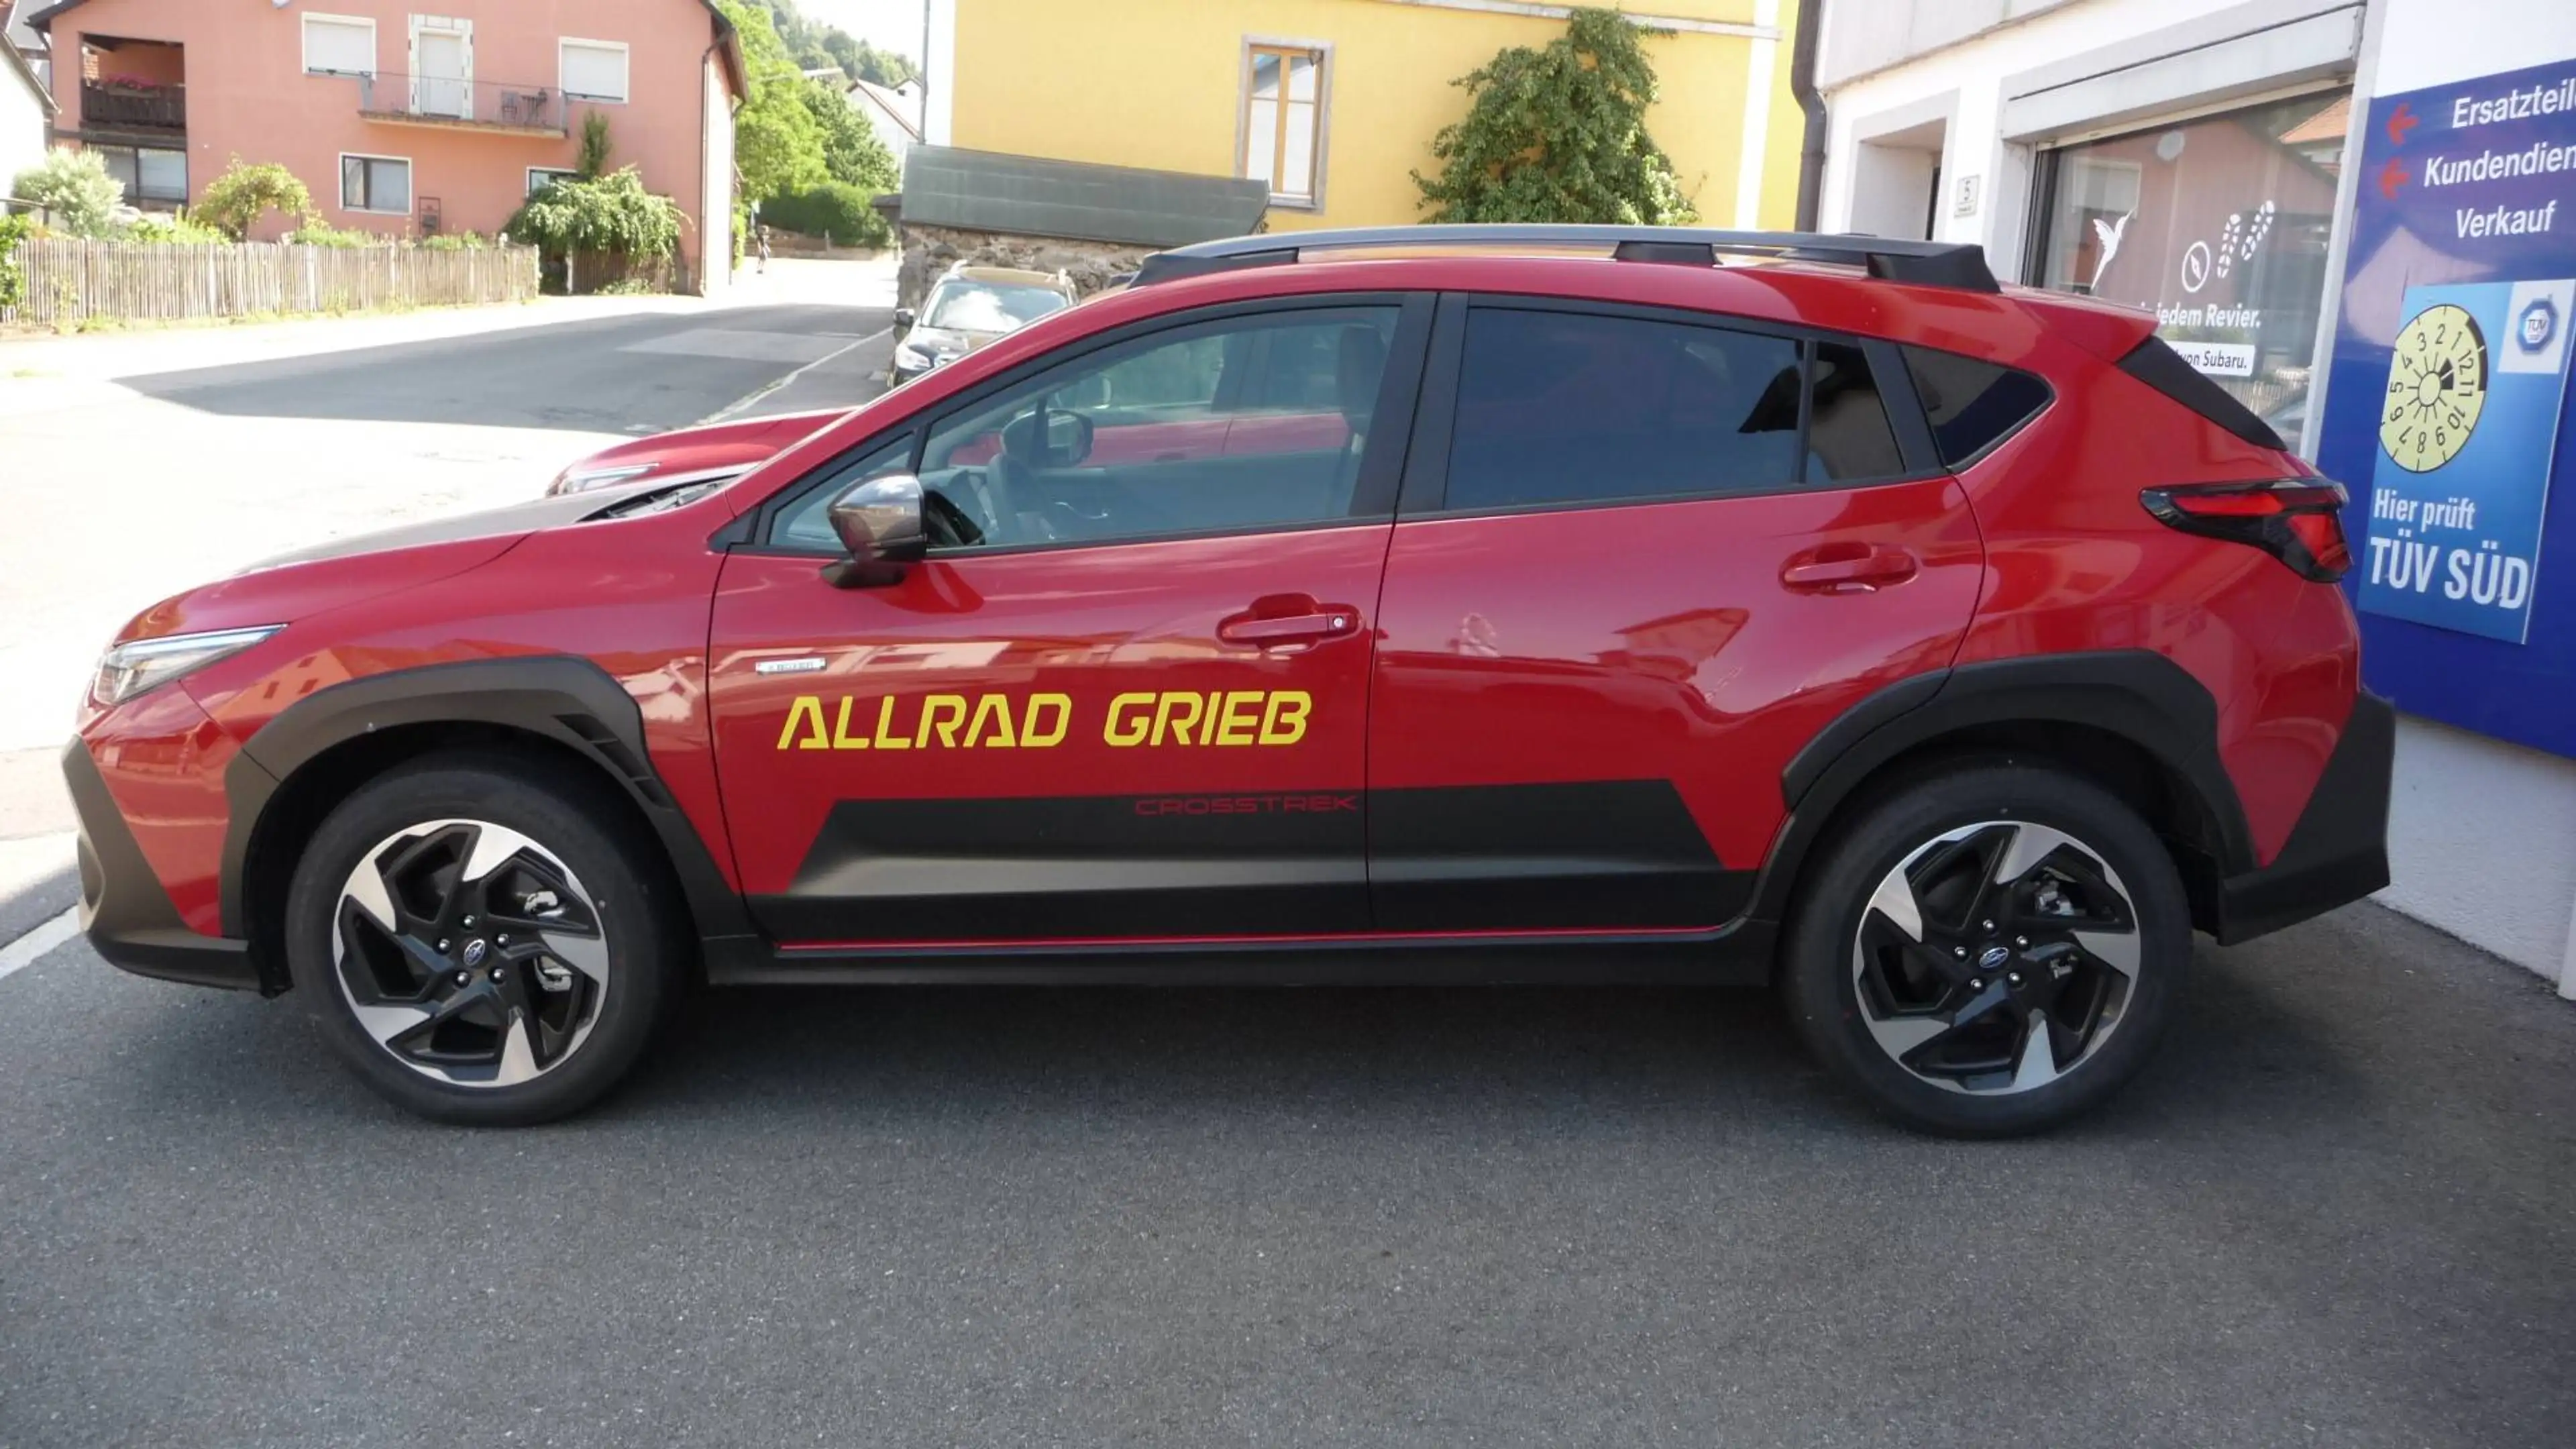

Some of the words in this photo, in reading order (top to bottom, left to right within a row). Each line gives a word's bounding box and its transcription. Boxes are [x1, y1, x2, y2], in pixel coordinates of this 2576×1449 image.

[2452, 78, 2576, 128] Ersatzteil
[2456, 199, 2557, 238] Verkauf
[2205, 303, 2261, 329] Revier.
[2417, 332, 2426, 352] 3
[2435, 323, 2445, 344] 2
[2451, 331, 2462, 350] 1
[2203, 348, 2247, 369] Subaru.
[2402, 354, 2413, 369] 4
[2458, 350, 2474, 374] 12
[2390, 382, 2404, 393] 5
[2458, 380, 2475, 397] 11
[2390, 406, 2404, 421] 6
[2447, 406, 2465, 429] 10
[2399, 426, 2412, 444] 7
[2417, 432, 2426, 453] 8
[2435, 427, 2445, 446] 9
[2373, 488, 2418, 523] Hier
[2420, 497, 2477, 533] prüft
[2370, 528, 2440, 592] TÜV
[2444, 539, 2529, 609] SÜD
[777, 692, 1072, 750] ALLRAD
[1103, 690, 1312, 746] GRIEB
[1134, 795, 1358, 817] CROSSTREK
